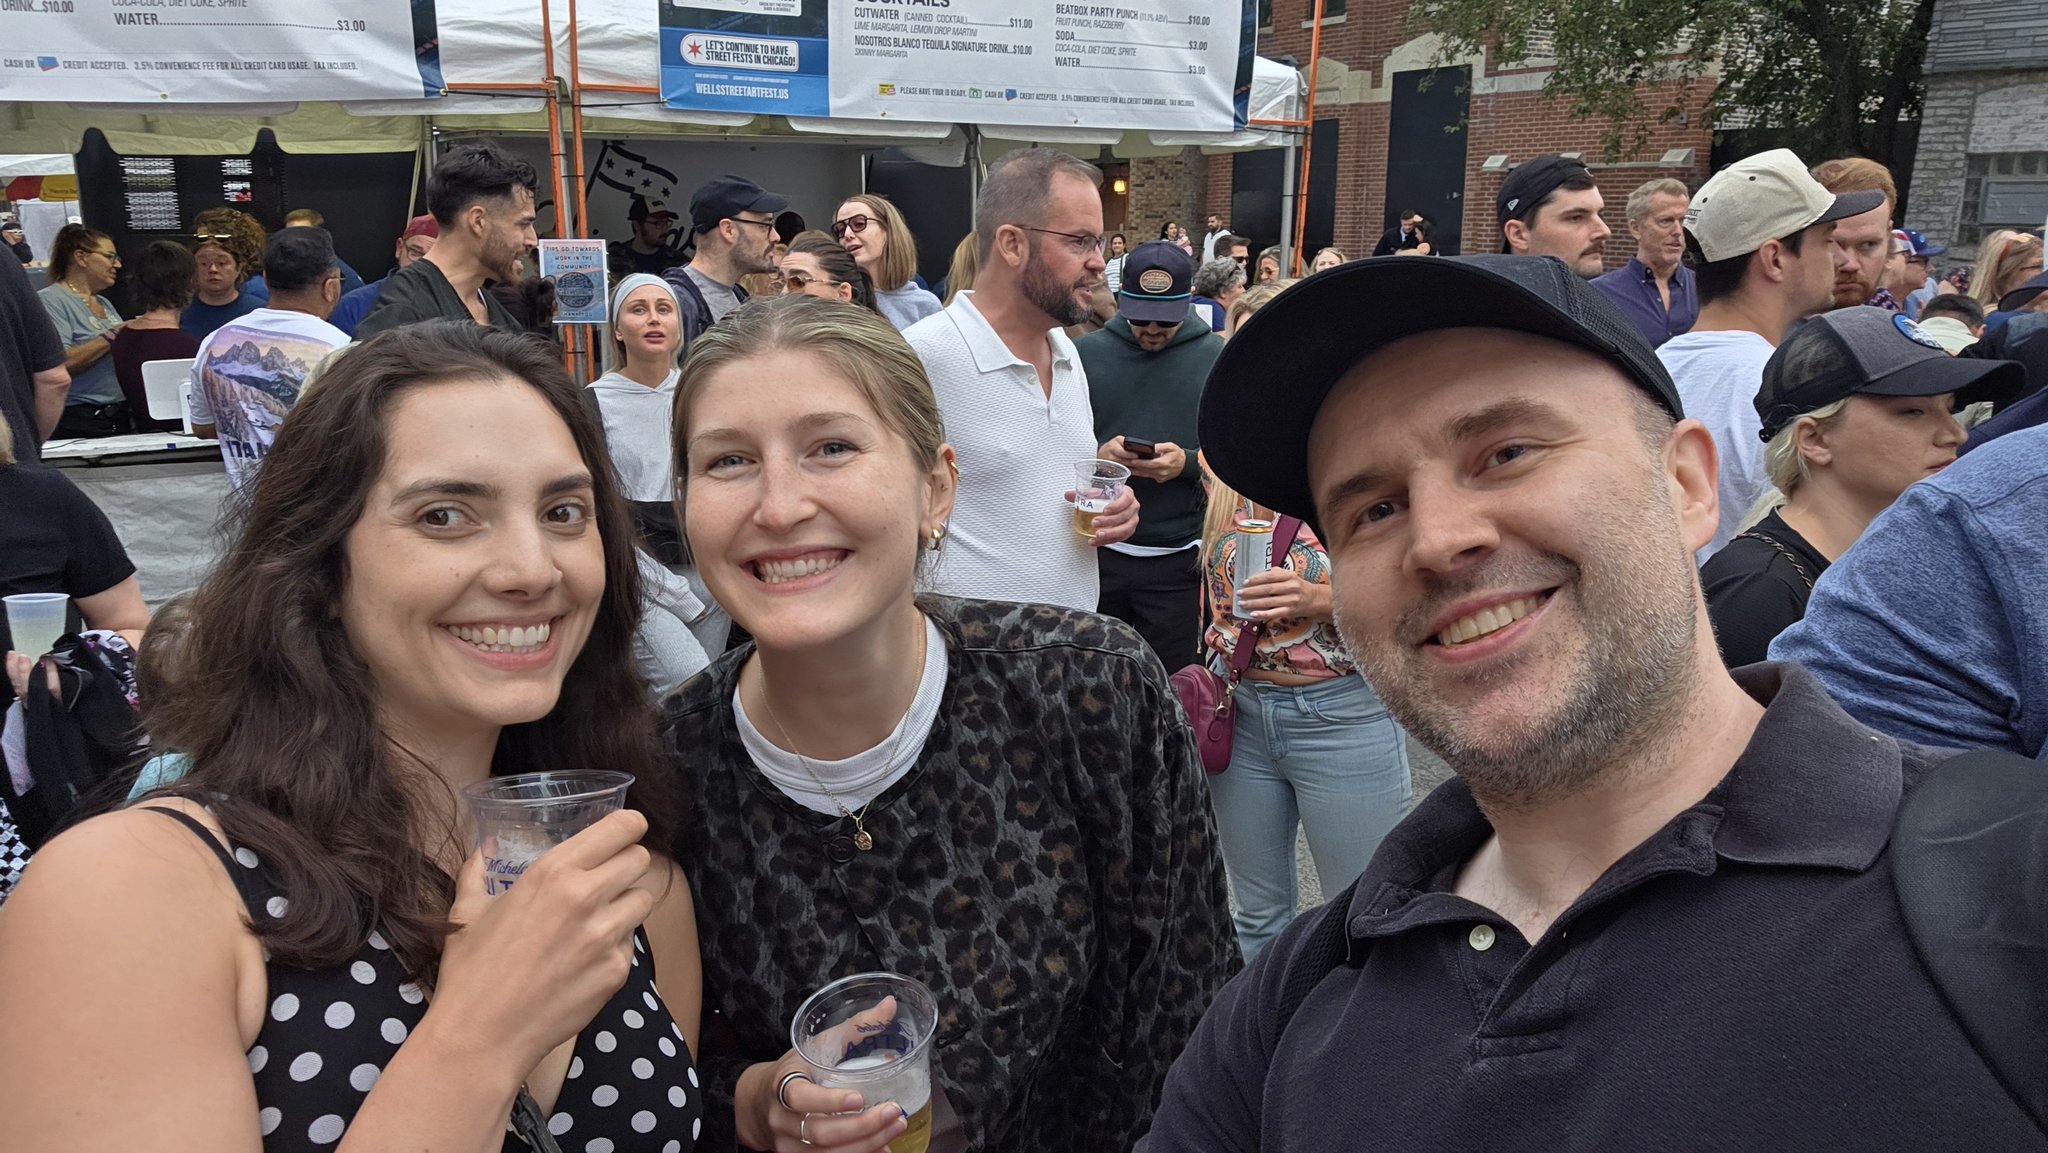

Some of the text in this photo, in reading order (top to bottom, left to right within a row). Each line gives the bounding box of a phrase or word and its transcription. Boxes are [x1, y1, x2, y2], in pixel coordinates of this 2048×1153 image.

[2, 0, 74, 13] DRINK $10.00
[1056, 4, 1088, 16] BEATBOX
[1090, 6, 1114, 18] PARTY
[1116, 8, 1139, 20] PUNCH
[1188, 15, 1211, 26] $10.00
[114, 13, 366, 32] WATER $3.00
[854, 7, 1033, 29] CUTWATER (CANNED COCKTAIL) $11.00
[1055, 17, 1125, 30] FRUIT PUNCH, RAZZBERRY
[854, 21, 979, 37] LIME MARGARITA, LEMON DROP MARTINI
[705, 39, 788, 56] LET'S CONTINUE TO HAVE
[854, 35, 1033, 55] NOSOTROS BLANCO TEQUILA SIGNATURE DRINK $10.00
[1055, 30, 1208, 51] SODA $3.00
[705, 50, 796, 67] STREET FESTS IN CHICAGO!
[854, 48, 909, 59] SKINNY MARGARITA
[1055, 44, 1087, 54] COCA-COLA,
[1088, 46, 1101, 55] DIET
[1118, 47, 1137, 57] SPRITE
[4, 59, 359, 71] CASH OR CREDIT ACCEPTED. 3.5% CONVENIENCE FEE FOR ALL CREDIT CARD USAGE. TAX INCLUDED.
[1055, 56, 1206, 75] WATER $3.00
[695, 83, 790, 100] WELLSSTREETARTFEST.US
[899, 86, 918, 95] PLEASE
[919, 87, 931, 95] HAVE
[931, 88, 944, 96] YOUR
[984, 90, 999, 98] CASH
[1076, 495, 1093, 509] TRA
[485, 857, 528, 874] Michel
